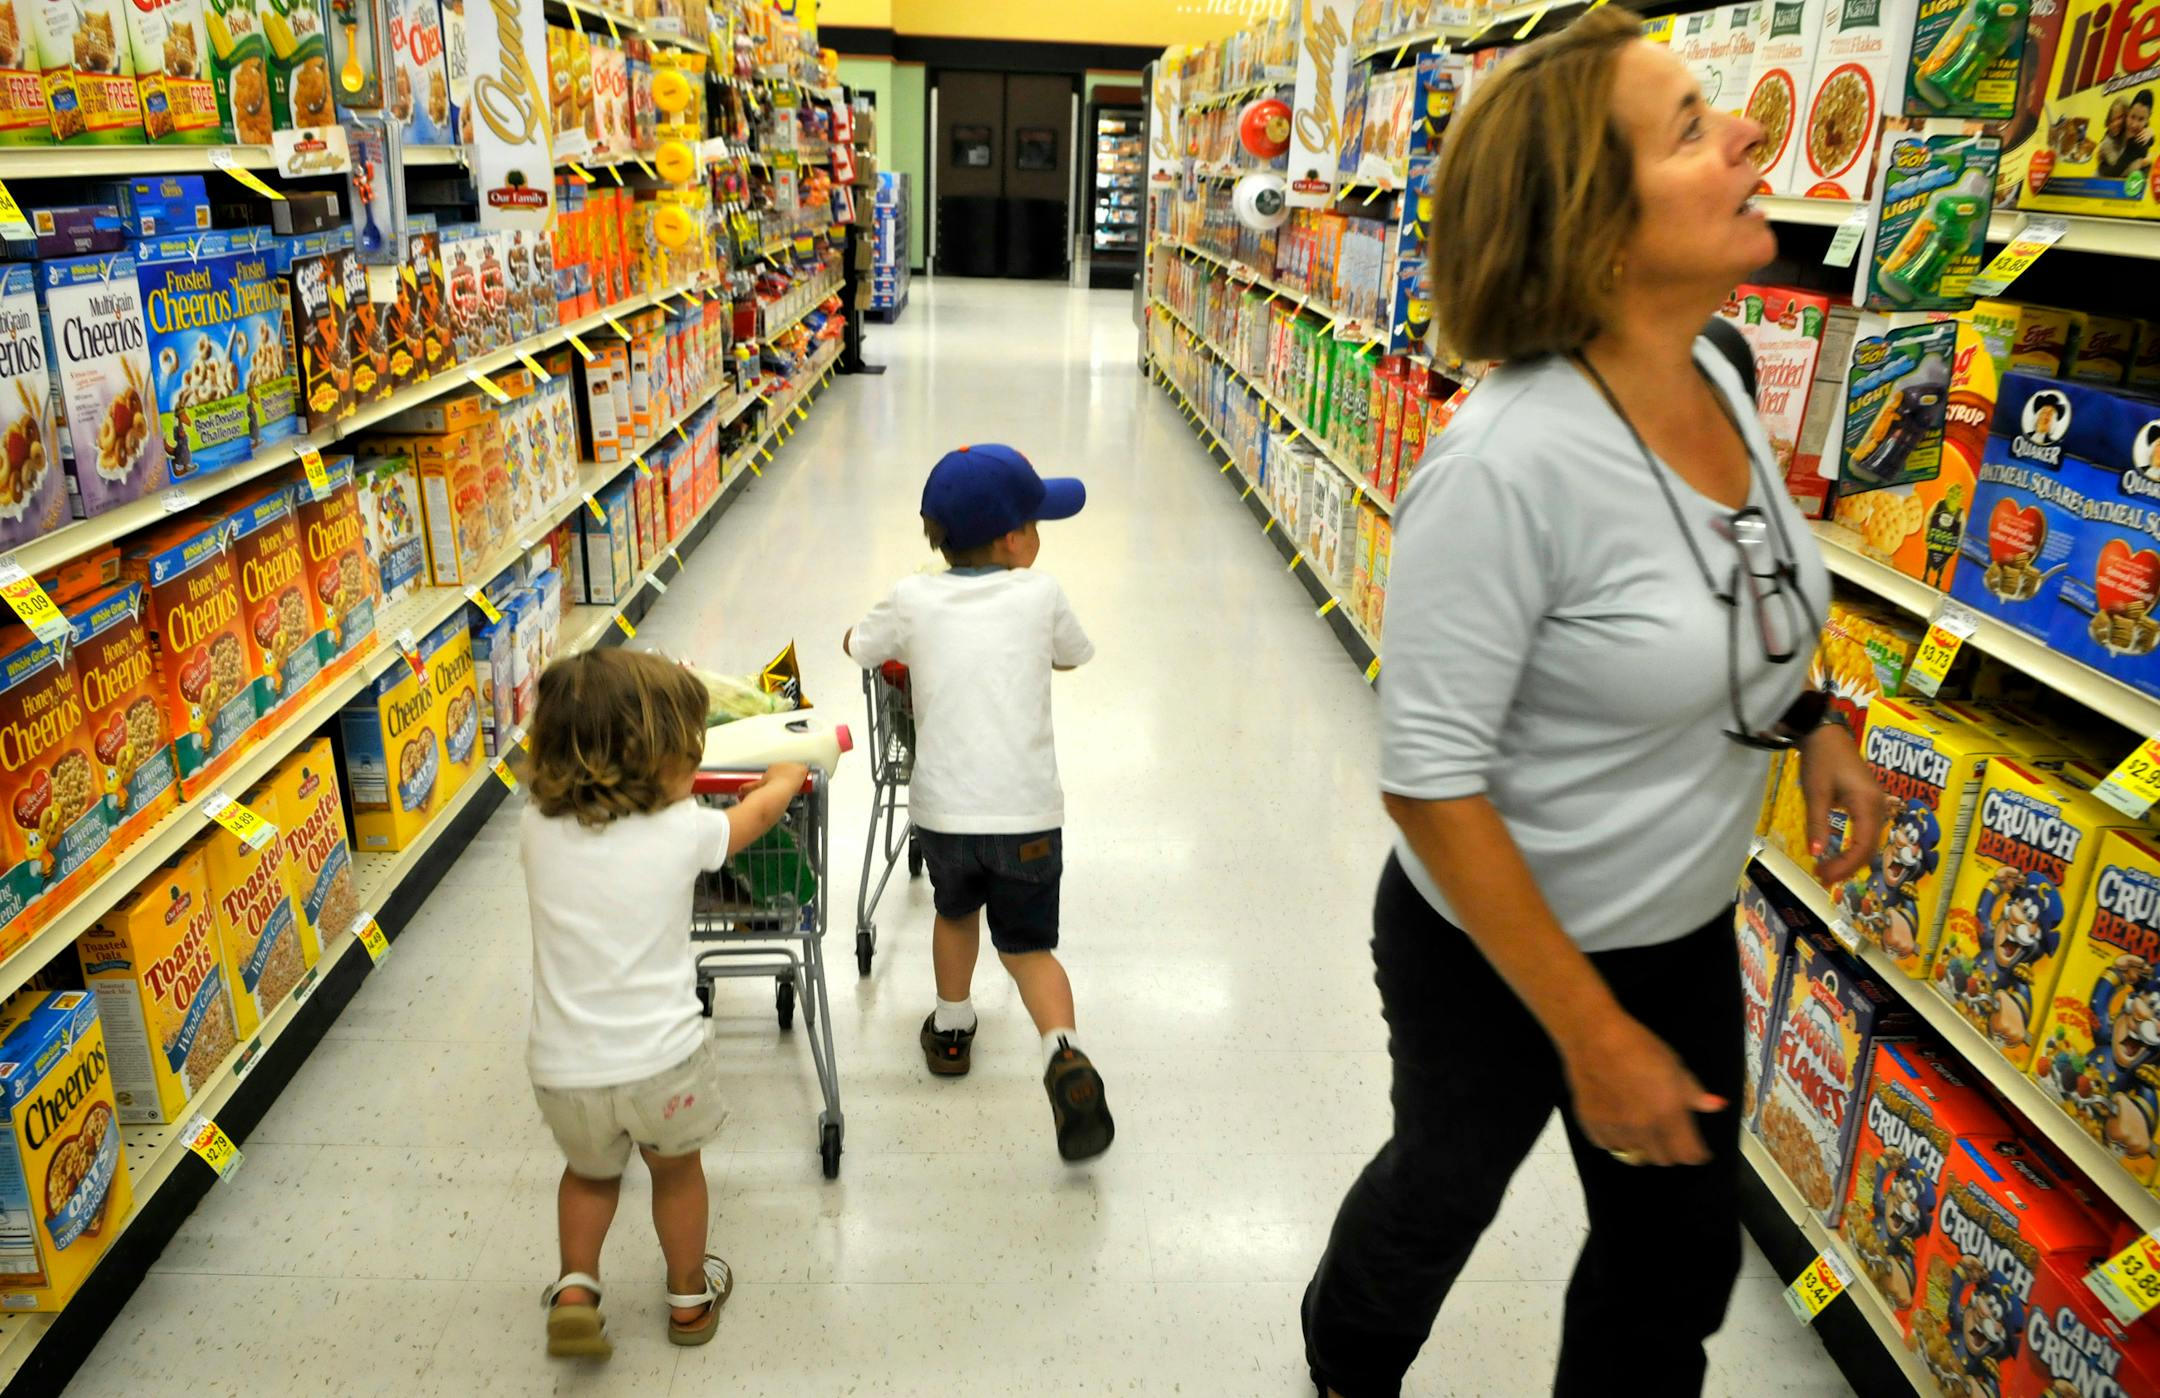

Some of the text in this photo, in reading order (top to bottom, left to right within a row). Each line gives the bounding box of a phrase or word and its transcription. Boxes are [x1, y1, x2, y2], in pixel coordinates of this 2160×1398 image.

[391, 16, 408, 51] ex
[1775, 11, 1800, 28] Kashi
[409, 23, 443, 66] Chex
[2057, 0, 2160, 101] life
[8, 77, 45, 111] FREE
[105, 80, 139, 112] FREE
[190, 84, 216, 112] FREE
[1896, 155, 1926, 168] GO!
[491, 190, 545, 206] Our Family
[1882, 195, 1929, 220] LIGHT
[166, 265, 212, 293] Frosted
[236, 257, 267, 281] Frosted
[89, 293, 134, 319] MultiGrain
[148, 287, 231, 334] Cheerios
[229, 276, 281, 318] heerios
[0, 335, 41, 378] erios
[63, 315, 143, 362] Cheerios
[1860, 350, 1888, 365] GO!
[1757, 386, 1790, 416] heat
[1849, 383, 1892, 415] LIGHT
[195, 416, 215, 432] Book
[215, 409, 245, 428] Donation
[201, 424, 241, 444] Challenge
[2012, 435, 2061, 466] QUAKER
[1980, 462, 2029, 489] OATMEAL
[323, 492, 355, 521] Honey Nut
[2083, 498, 2144, 530] OATMEAL
[259, 522, 296, 557] Honey Nut
[308, 510, 360, 562] Cheerios
[188, 561, 231, 602] Honey Nut
[243, 543, 302, 604] Cheerios
[16, 594, 49, 617] $3.09
[90, 600, 128, 627] Whole Grain
[168, 584, 238, 654] Cheerios
[103, 626, 146, 665] Honey Nut
[1922, 644, 1950, 669] $3.73
[1932, 627, 1960, 647] LOW
[7, 645, 51, 677] Whole Grain
[83, 644, 153, 714] Cheerios
[435, 646, 471, 695] Cheerios
[22, 671, 73, 719] Honey Nut
[388, 685, 433, 738] Cheerios
[0, 694, 82, 773] Cheerios
[136, 756, 168, 789] Lowering
[1867, 729, 1951, 789] CRUNCH
[65, 814, 101, 853] Lowering
[285, 774, 341, 864] Toasted
[1981, 792, 2082, 864] CRUNCH
[61, 822, 110, 876] Cholesterol!
[307, 819, 340, 875] Oats
[1976, 827, 2070, 887] BERRIES
[222, 831, 285, 928] Toasted
[311, 874, 331, 910] Whole
[2098, 868, 2160, 929] CRUN
[246, 877, 283, 939] Oats
[83, 939, 127, 954] Toasted
[95, 950, 122, 962] Oats
[144, 892, 213, 1003] Toasted
[250, 909, 291, 978] Whole Grain
[2090, 906, 2160, 966] BERR
[174, 944, 212, 1012] Oats
[179, 975, 218, 1052] Whole Grain
[1789, 1005, 1848, 1086] FROSTED
[25, 1041, 106, 1151] Cheerios
[1777, 1030, 1851, 1130] FLAKES
[194, 1122, 217, 1149] LOW
[206, 1135, 228, 1163] $2.79
[1868, 1097, 1945, 1185] CRUNCH
[68, 1145, 109, 1219] OATS
[56, 1219, 86, 1250] LOWER
[1940, 1194, 2035, 1304] CRUNCH
[1804, 1272, 1829, 1305] $3.44
[1815, 1257, 1842, 1289] LOW
[2028, 1312, 2130, 1398] CRUN
[2056, 1306, 2122, 1377] CAP'N
